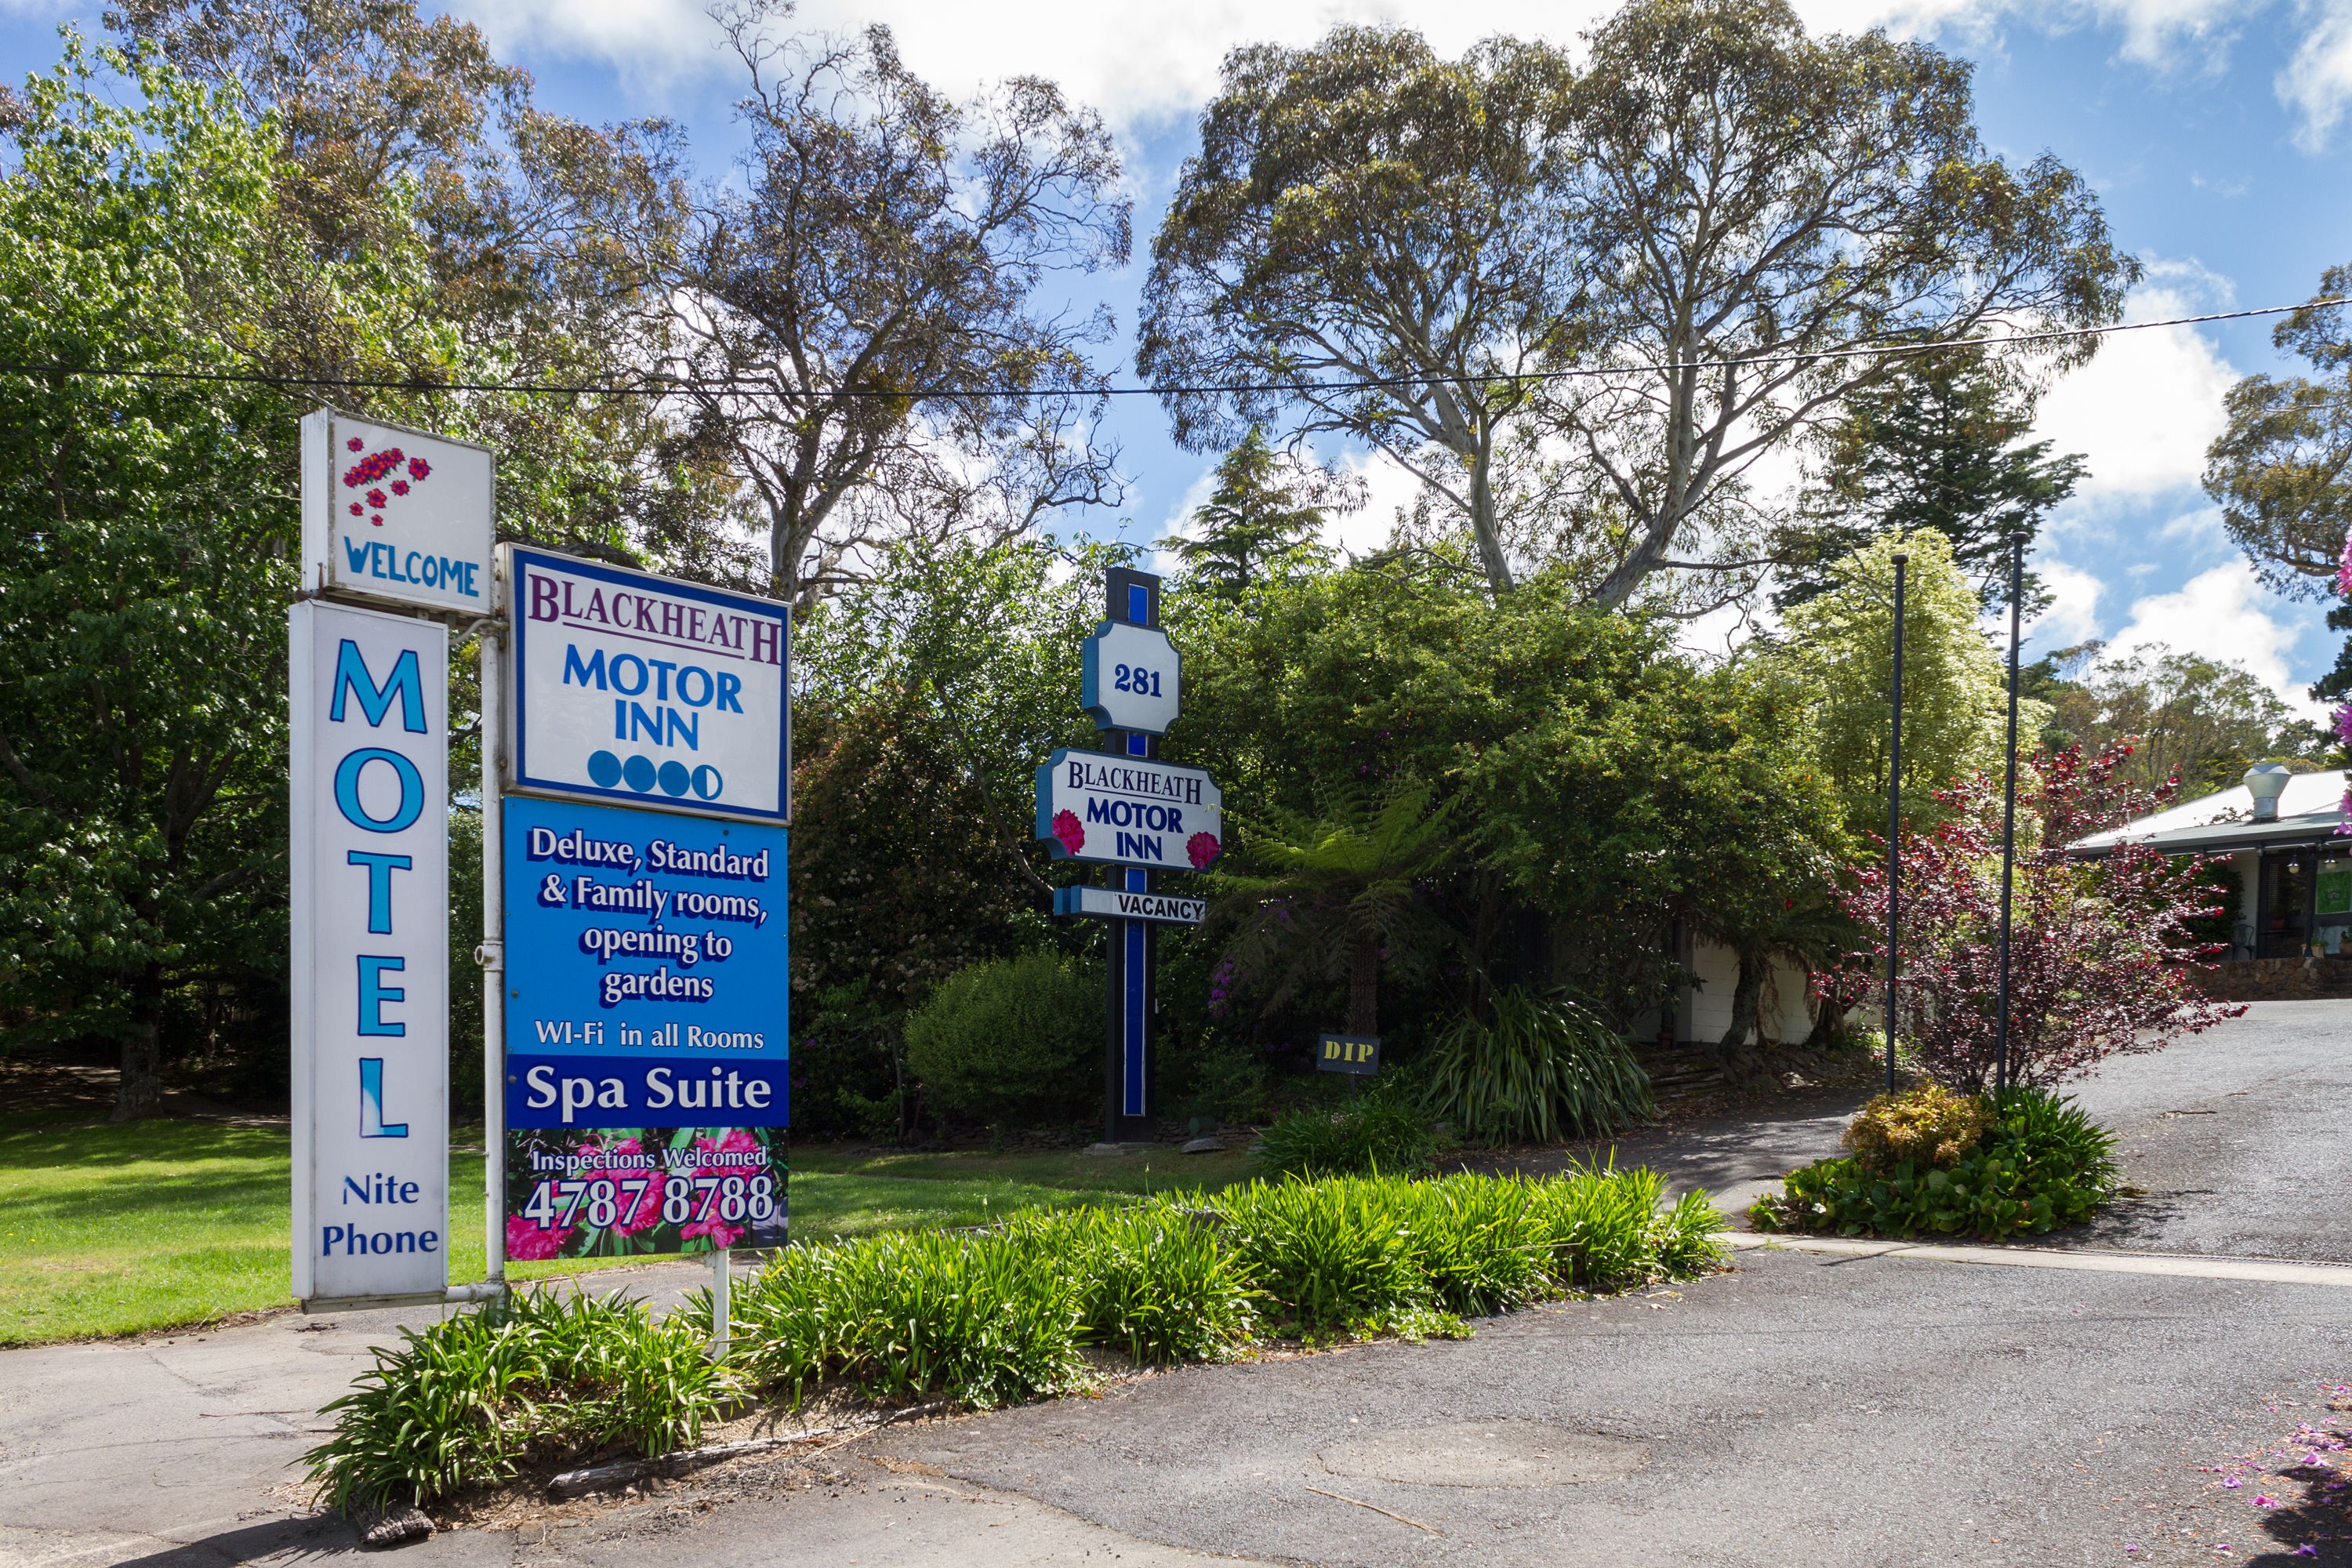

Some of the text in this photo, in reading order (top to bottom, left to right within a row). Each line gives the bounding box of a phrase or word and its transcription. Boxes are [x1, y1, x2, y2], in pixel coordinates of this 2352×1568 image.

[343, 536, 479, 597] WELCOME
[528, 573, 782, 666] BLACKHEATH
[562, 643, 745, 714] MOTOR
[1114, 663, 1162, 698] 281
[615, 699, 699, 751] INN
[1067, 761, 1203, 805] BLACKHEATH
[1086, 797, 1185, 834] MOTOR
[530, 827, 770, 878] Deluxe, Standard
[1116, 831, 1163, 861] INN
[329, 638, 428, 1140] MOTEL
[541, 874, 768, 924] & Family rooms,
[1118, 895, 1204, 920] VACANCY
[583, 925, 733, 964] opening to
[604, 967, 714, 1003] gardens
[535, 1021, 764, 1049] WI-Fi in all Rooms
[1323, 1040, 1374, 1062] DIP
[525, 1065, 771, 1123] Spa Suite
[532, 1145, 768, 1172] Inspections Welcomed
[343, 1174, 419, 1205] Nite
[524, 1176, 775, 1229] 4787 8788
[322, 1222, 439, 1257] Phone
